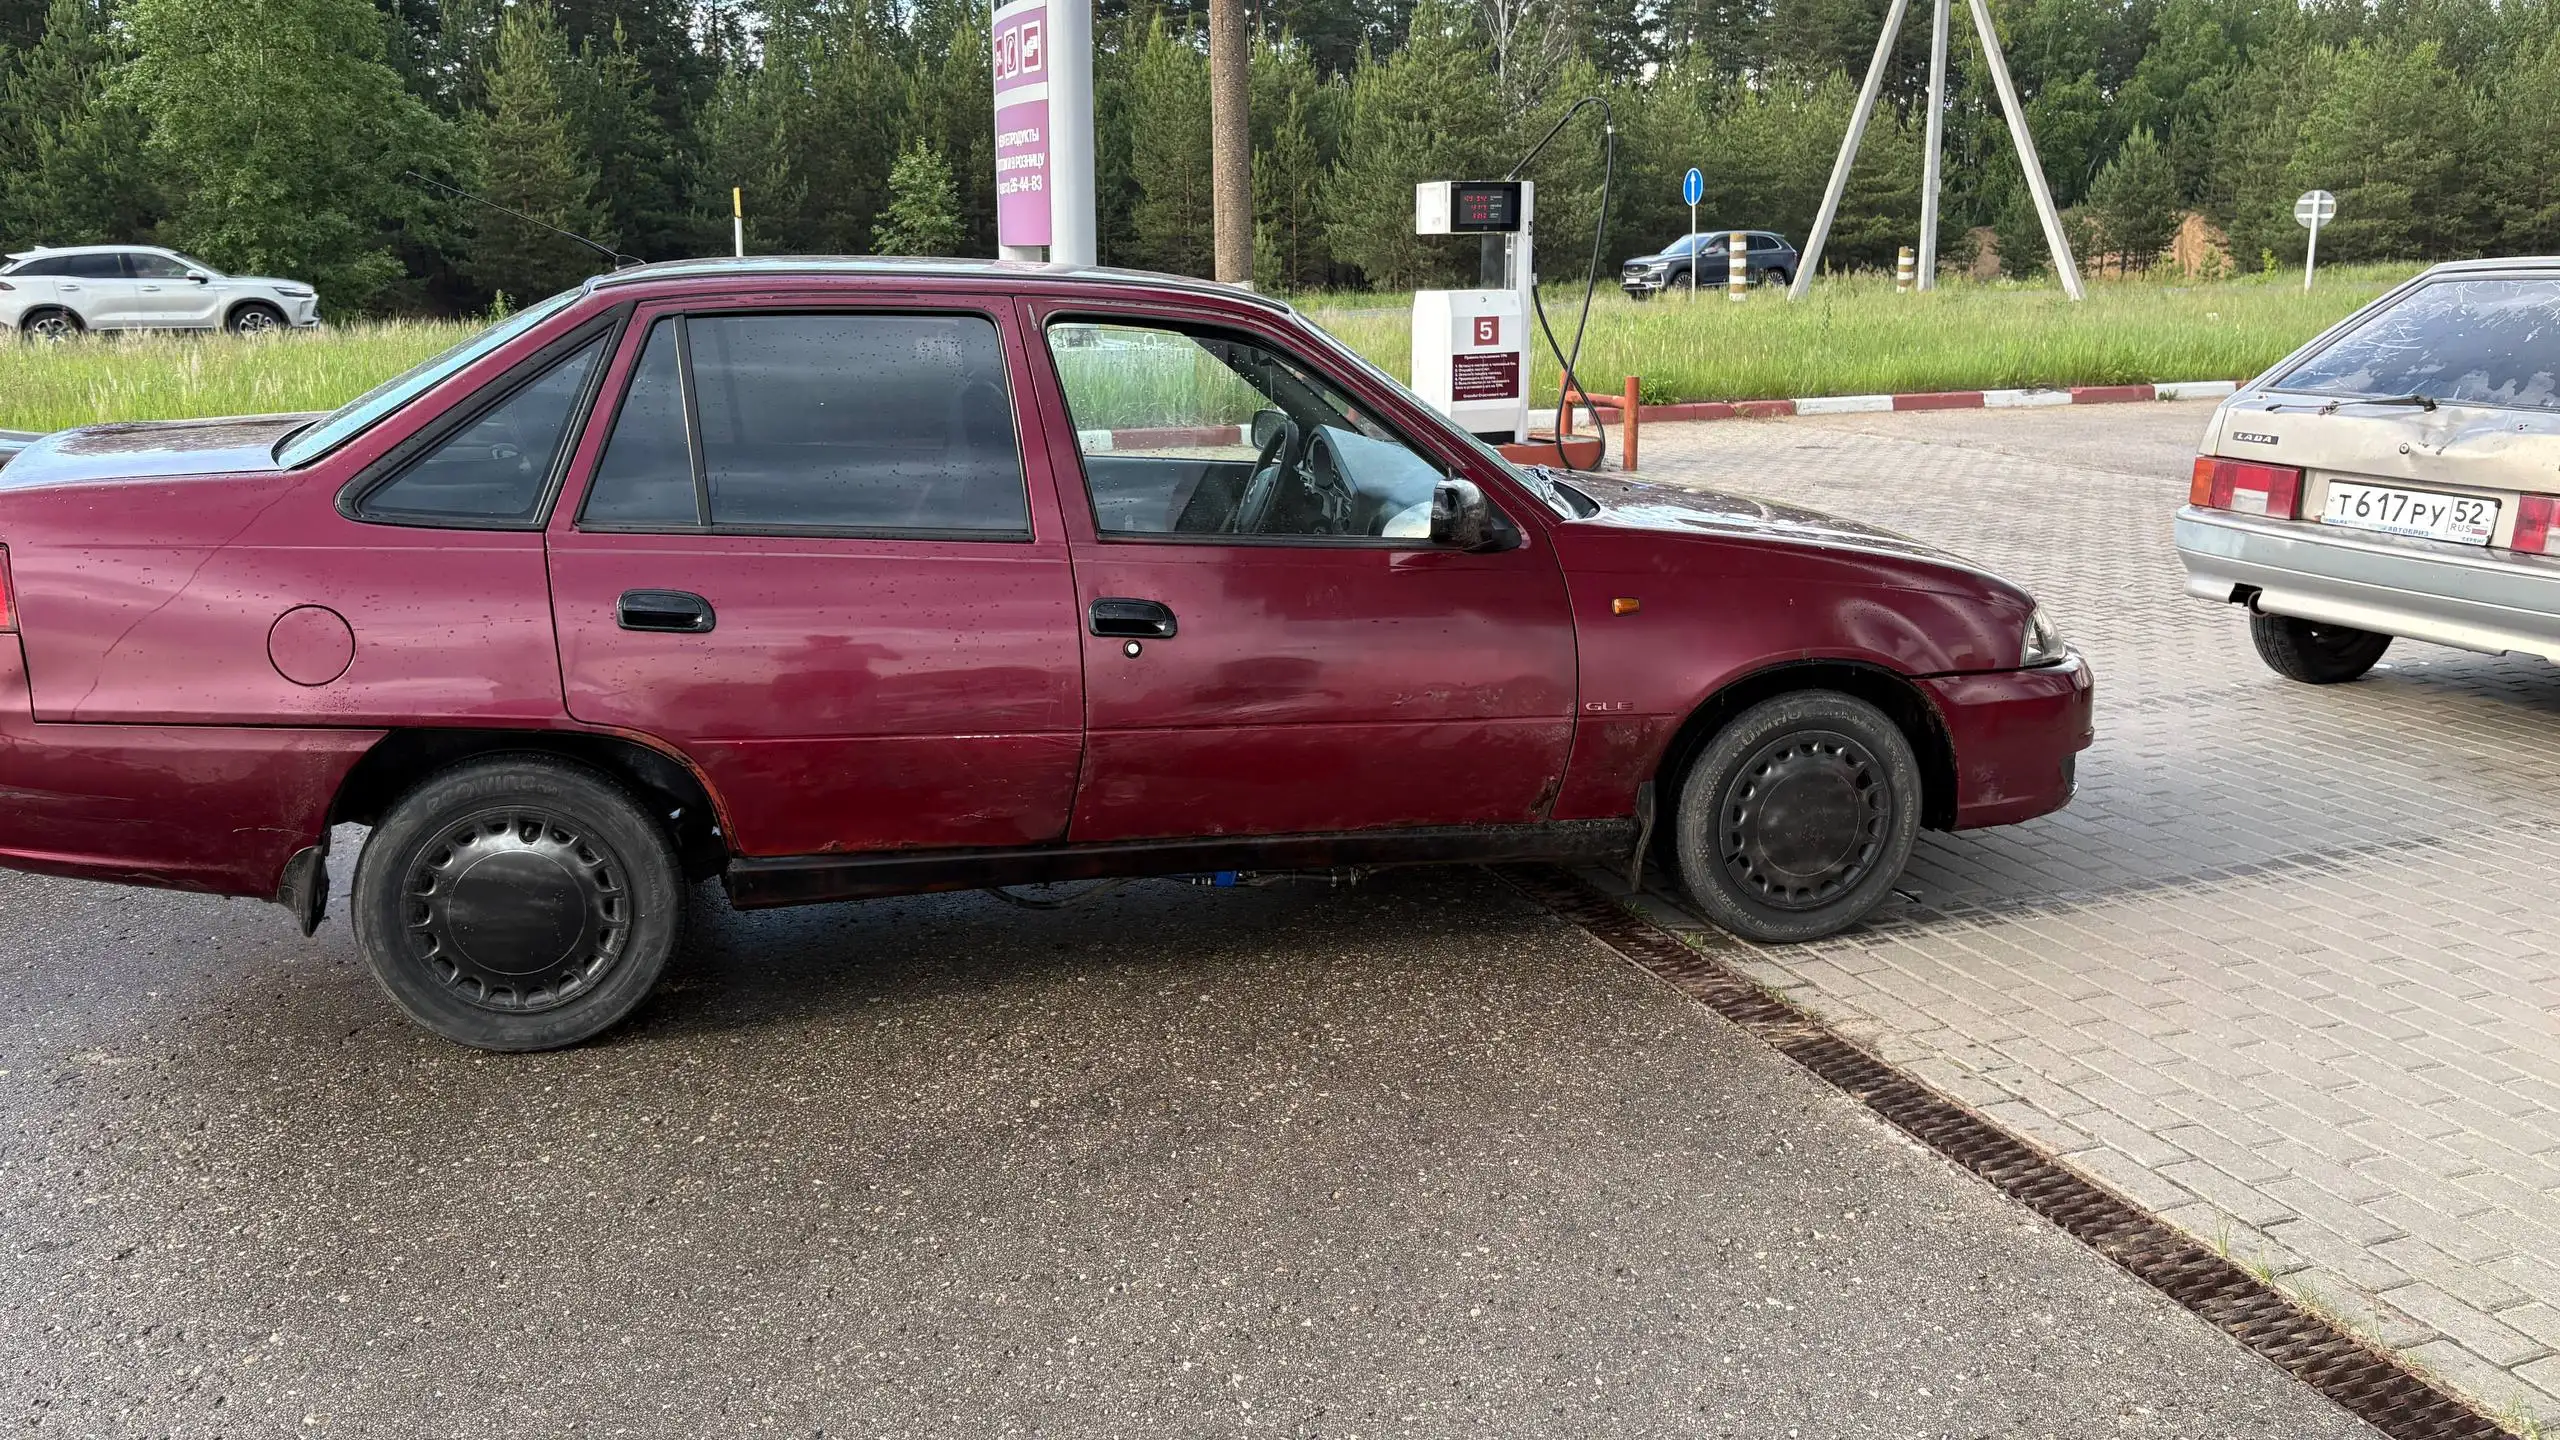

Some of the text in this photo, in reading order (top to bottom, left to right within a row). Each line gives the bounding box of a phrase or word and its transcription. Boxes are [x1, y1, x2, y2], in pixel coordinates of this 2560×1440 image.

[1480, 321, 1492, 340] 5
[2237, 433, 2272, 443] LADA
[2339, 491, 2484, 527] Т617РУ 52
[2450, 523, 2471, 533] RUS
[1585, 701, 1633, 711] GLE
